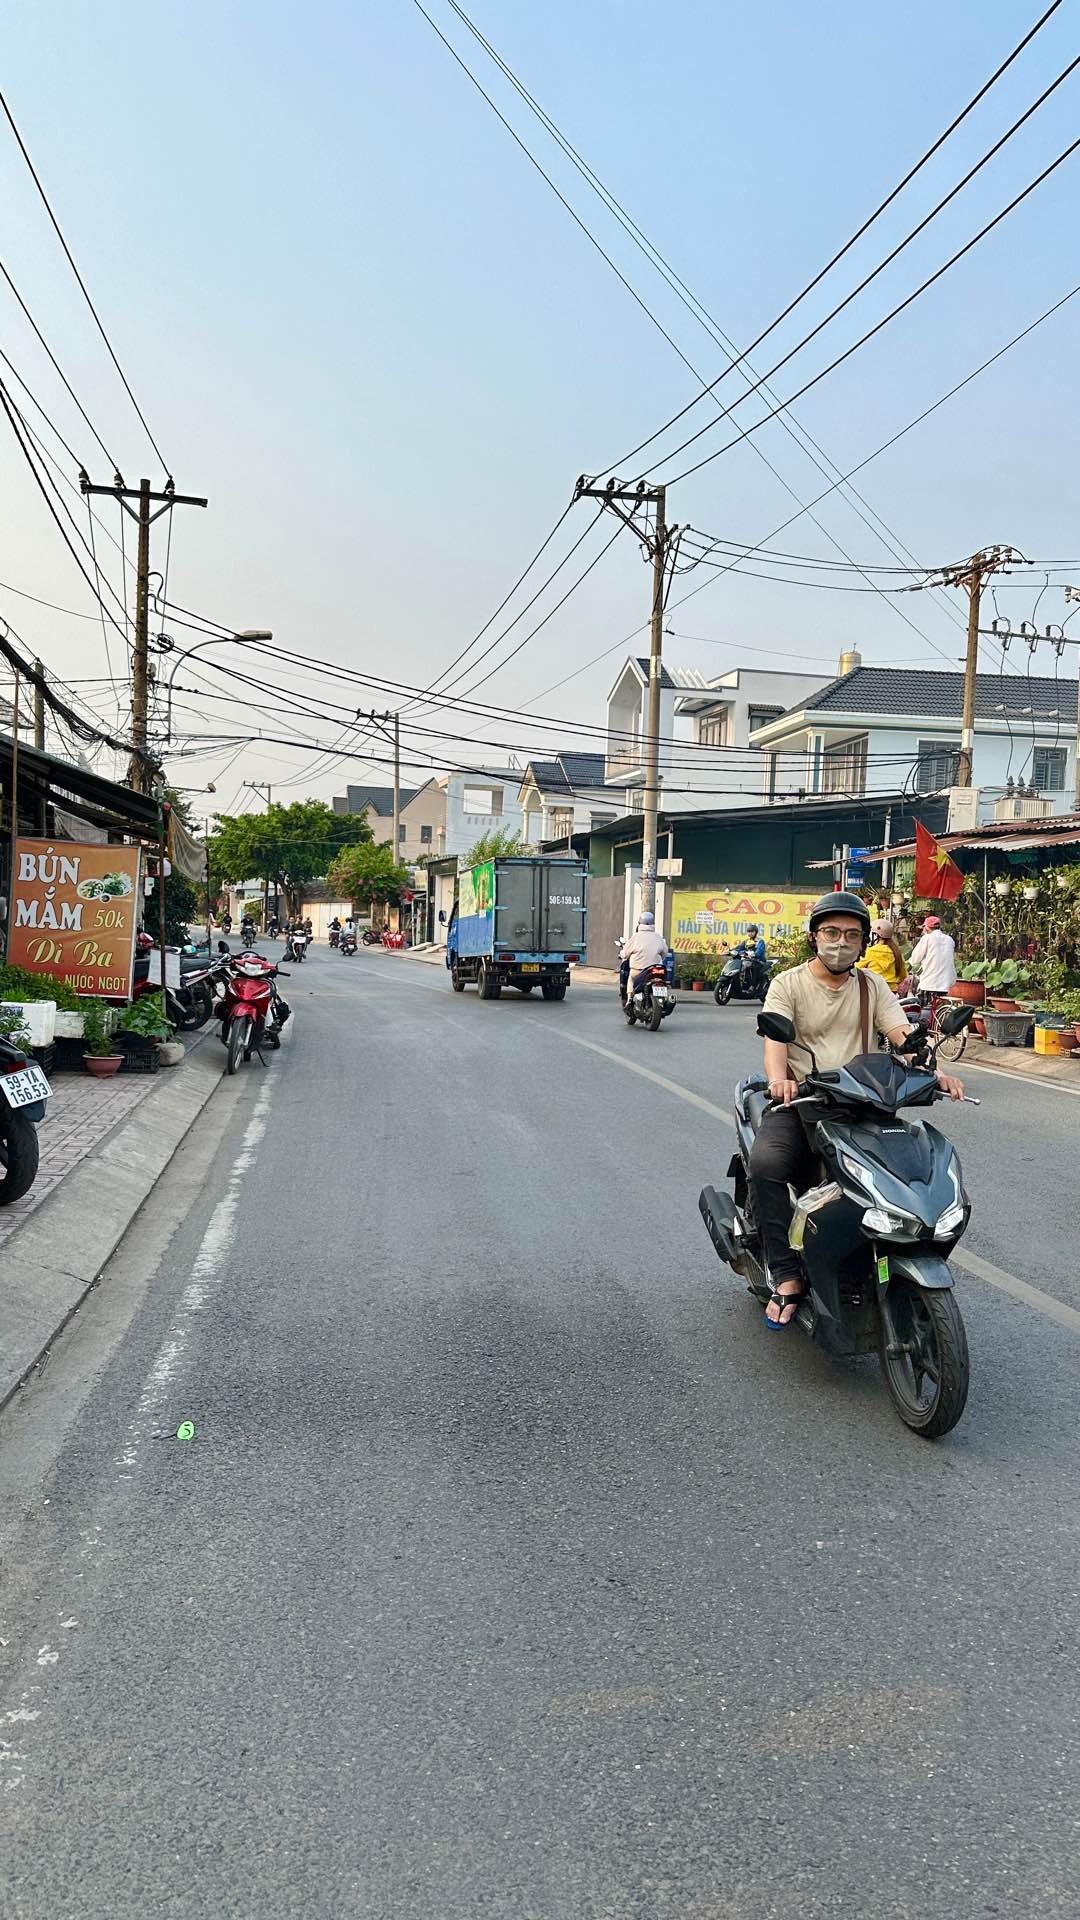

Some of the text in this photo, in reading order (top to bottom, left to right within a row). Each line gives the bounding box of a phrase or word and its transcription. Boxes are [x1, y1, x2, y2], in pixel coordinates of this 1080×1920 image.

[18, 847, 81, 885] BÚN
[15, 886, 126, 931] MẮM 50k
[705, 898, 783, 916] CAO
[732, 919, 765, 937] VŨG
[27, 938, 113, 967] Dì Ba
[98, 975, 127, 993] NGỌT
[5, 1070, 39, 1090] 59-YA
[11, 1083, 48, 1104] 156.53
